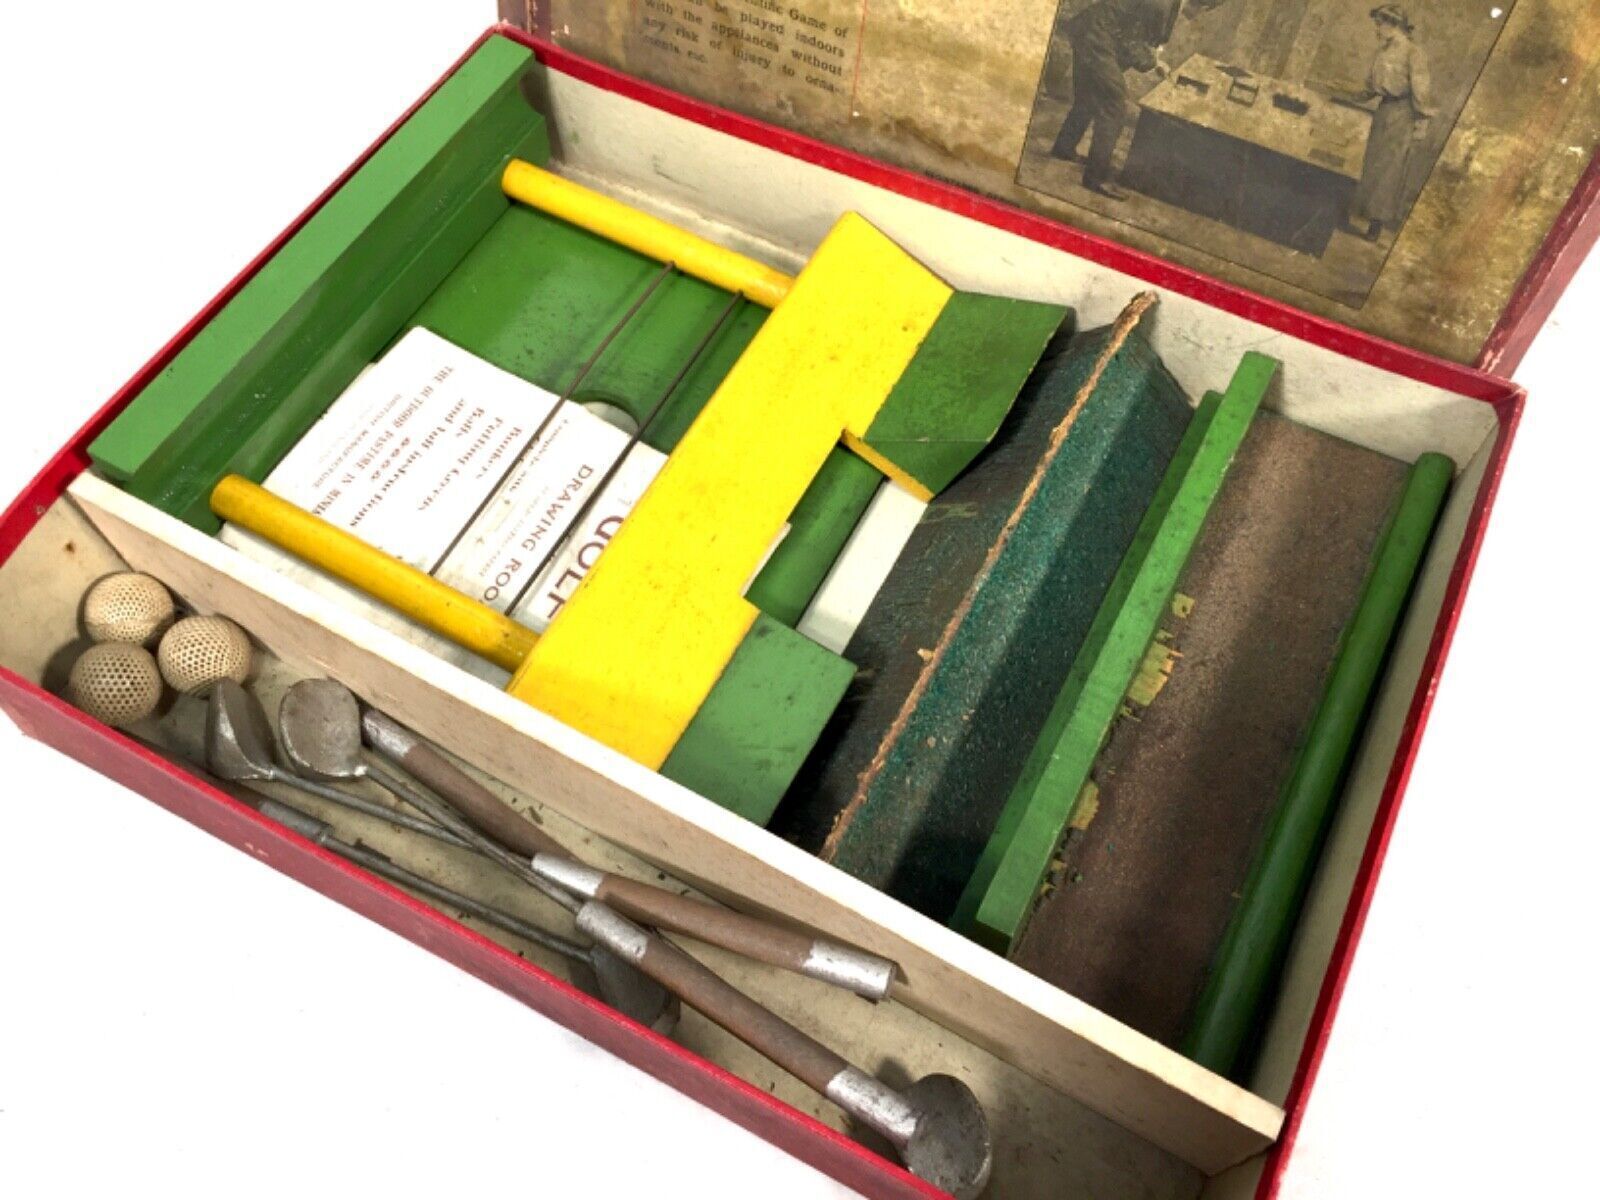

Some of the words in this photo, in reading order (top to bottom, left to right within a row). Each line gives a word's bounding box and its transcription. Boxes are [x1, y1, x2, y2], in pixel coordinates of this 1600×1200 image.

[682, 9, 703, 25] the
[791, 48, 842, 76] without
[714, 1, 729, 16] be
[741, 12, 784, 34] played
[795, 31, 845, 57] indoors
[789, 8, 827, 31] Game
[834, 27, 849, 38] of
[675, 26, 699, 42] risk
[709, 39, 722, 50] of
[732, 45, 771, 69] injury
[781, 63, 795, 77] to
[434, 366, 454, 384] THE
[393, 385, 433, 428] OUTDOOR
[444, 398, 467, 424] and
[456, 407, 486, 438] Balls
[355, 430, 395, 470] PASTIME
[421, 425, 446, 450] full
[457, 416, 504, 465] Putting
[341, 472, 356, 485] IN
[350, 450, 422, 528] instructions
[520, 463, 595, 552] DRAWING
[479, 557, 523, 604] ROO
